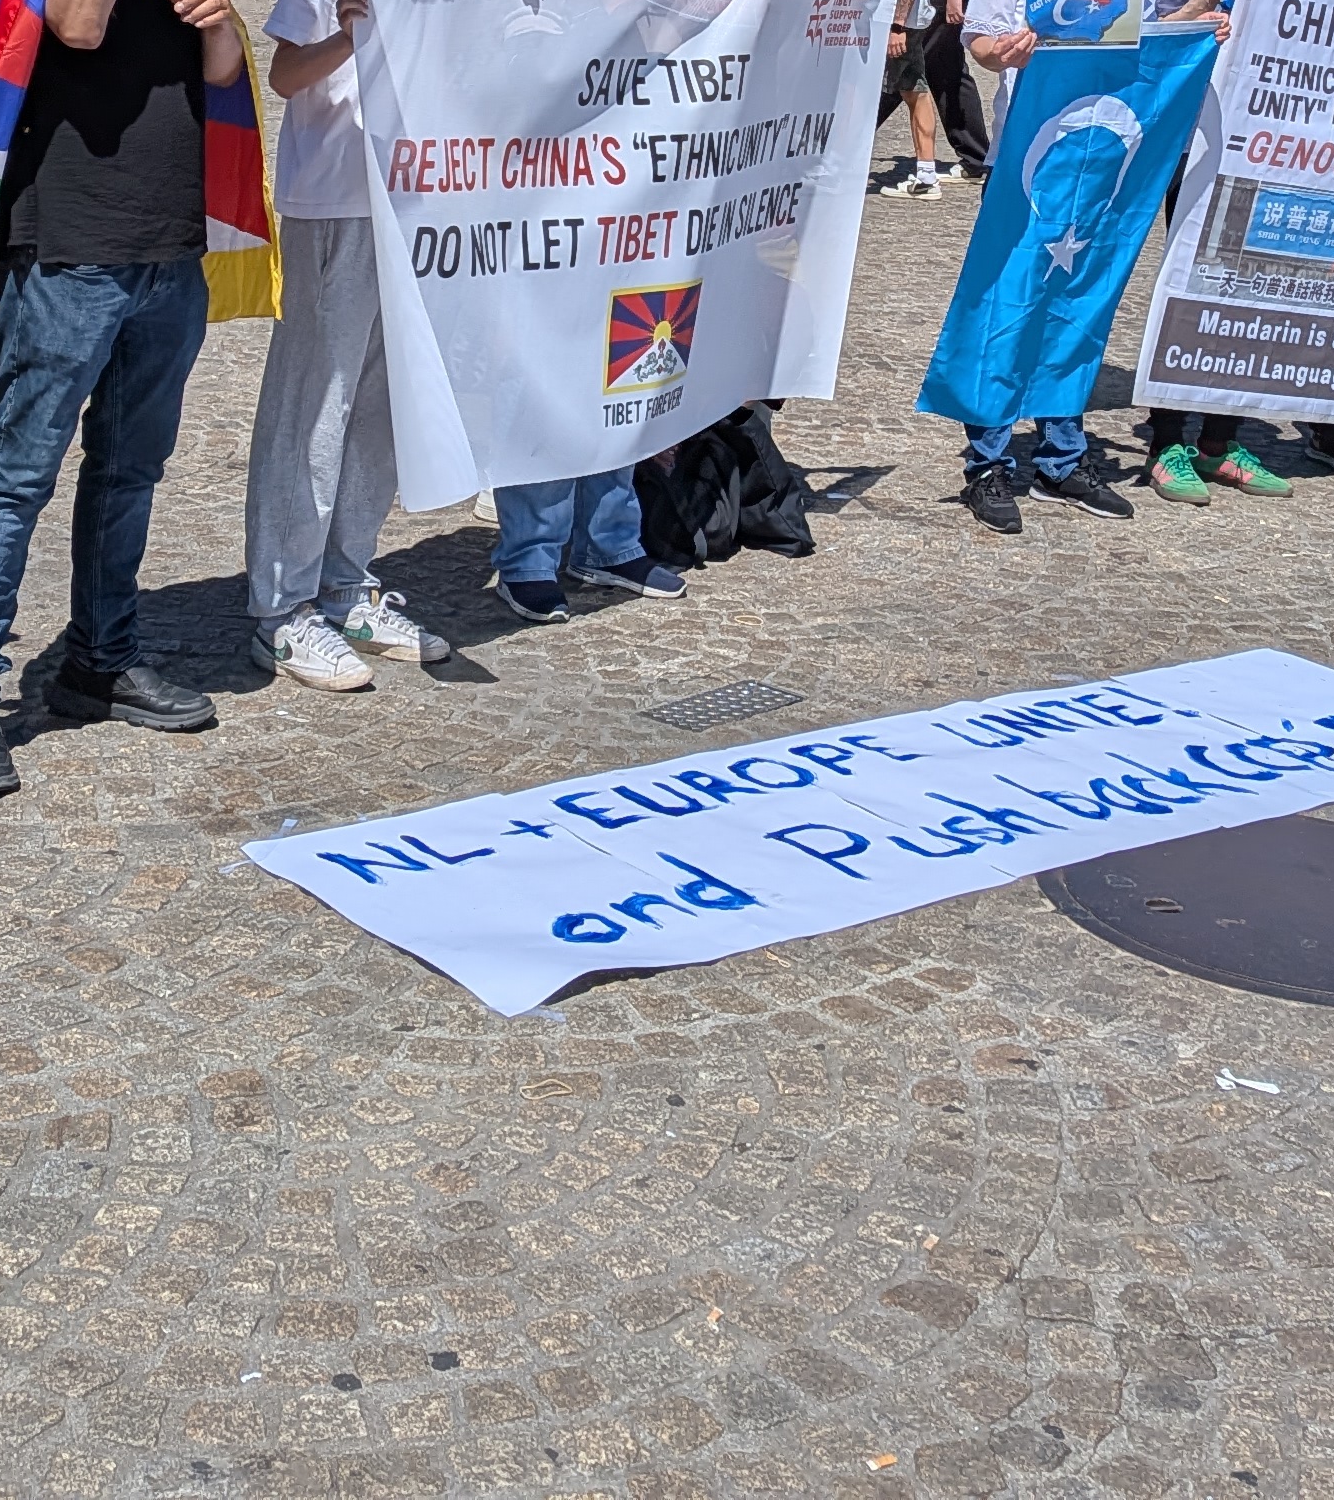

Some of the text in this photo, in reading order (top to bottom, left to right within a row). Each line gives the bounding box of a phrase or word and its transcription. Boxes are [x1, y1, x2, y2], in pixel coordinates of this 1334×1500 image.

[827, 23, 851, 33] GROEP
[829, 10, 863, 20] SUPPORT
[824, 37, 870, 46] NEDERLAND
[578, 54, 751, 107] SAVE TIBET
[1247, 87, 1328, 124] UNITY"
[388, 137, 495, 193] REJECT
[501, 133, 626, 189] CHINA’S
[786, 113, 835, 158] LAW
[413, 182, 803, 280] DO NOT LET TIBET DIE IN SILENCE
[1198, 310, 1302, 344] Mandarin
[1307, 324, 1326, 347] is
[1165, 346, 1254, 376] Colonial
[602, 400, 643, 428] TIBET
[316, 835, 496, 884] NL
[500, 819, 555, 839] +
[551, 734, 932, 830] EUROPE
[551, 851, 766, 944] and
